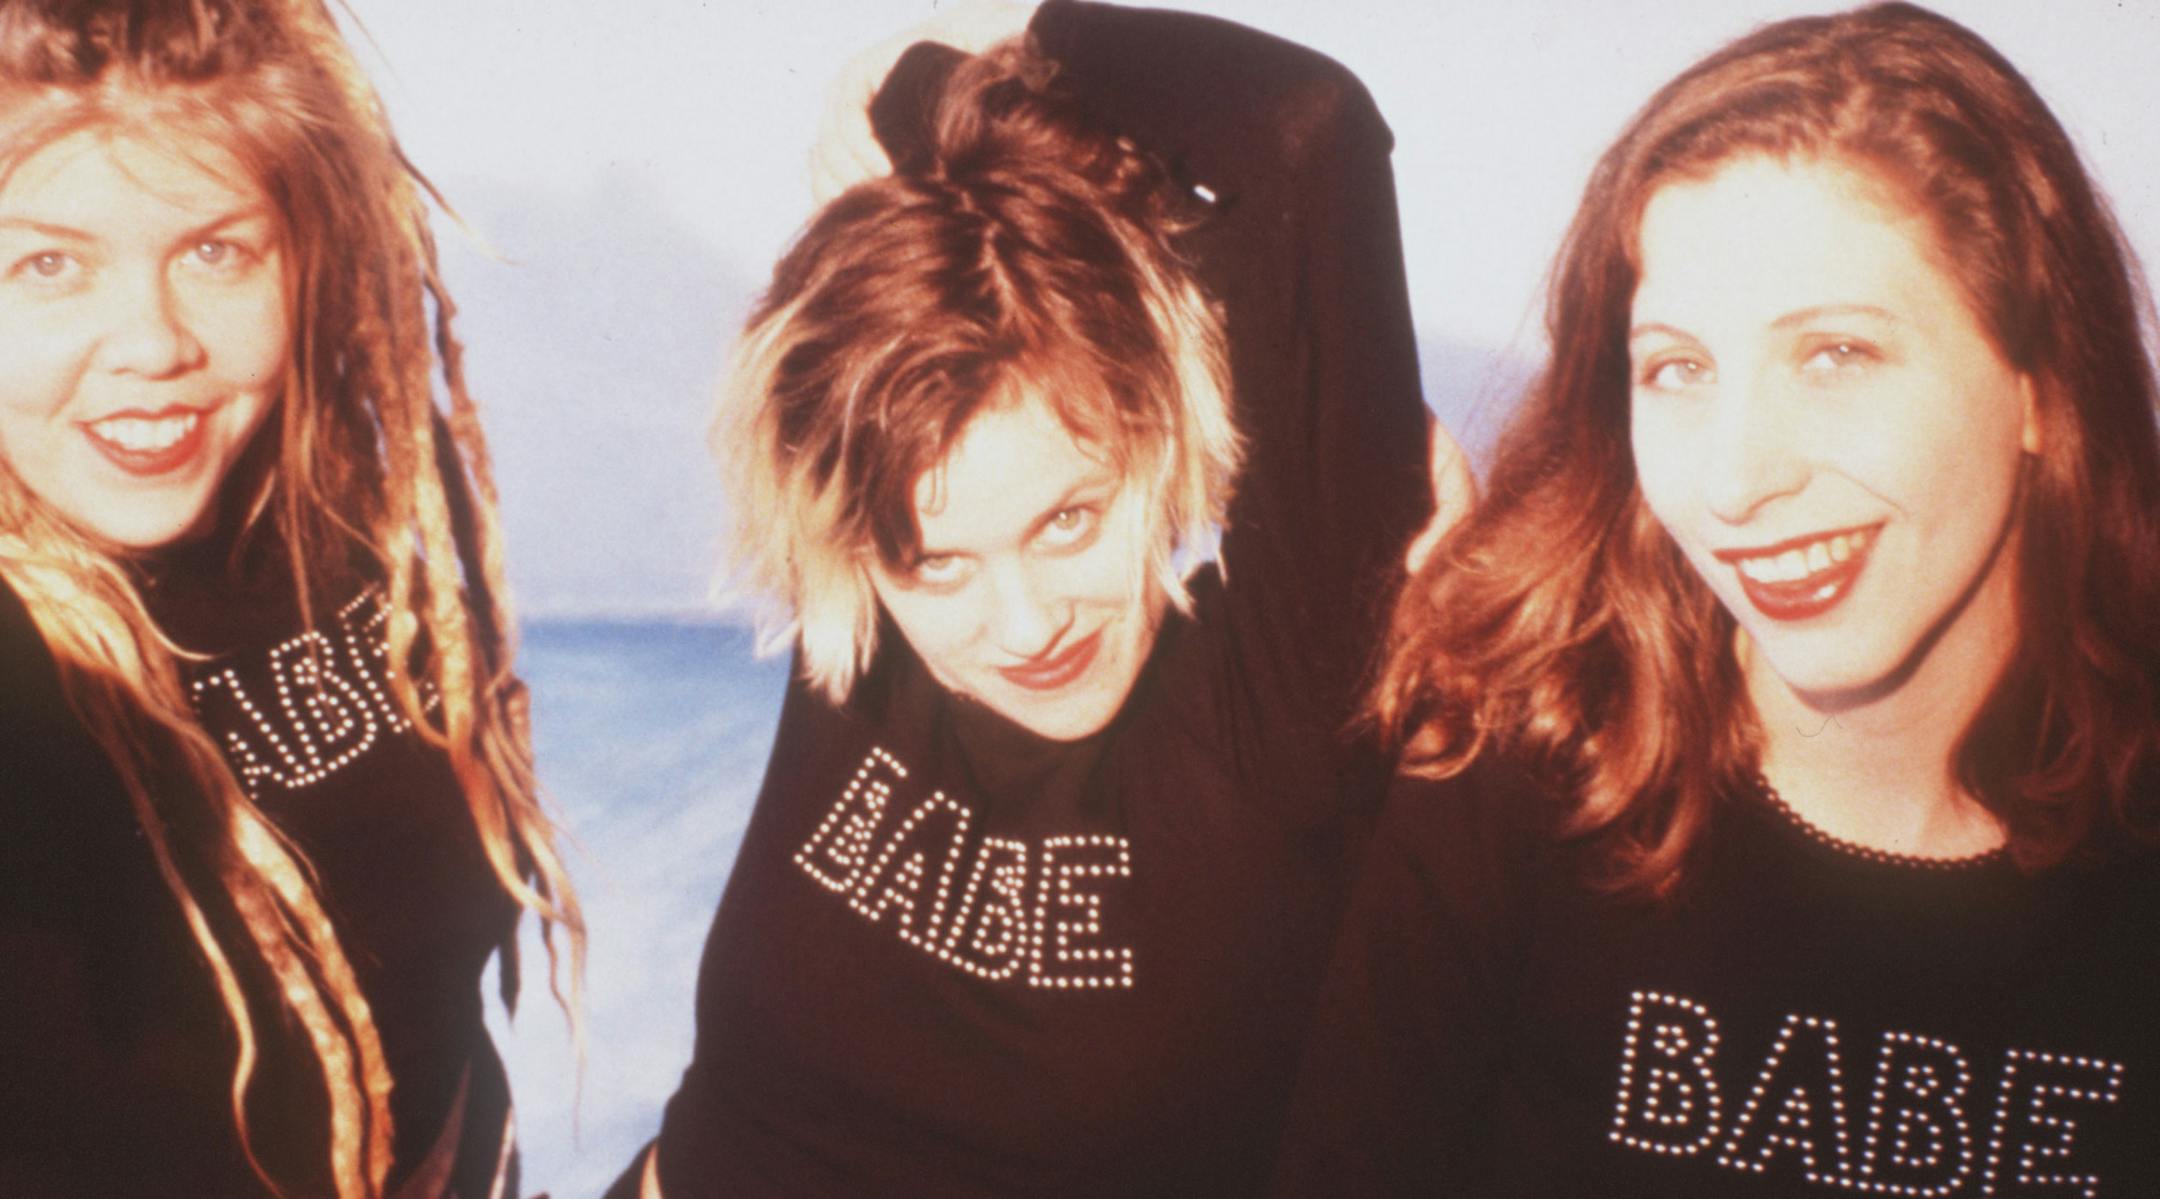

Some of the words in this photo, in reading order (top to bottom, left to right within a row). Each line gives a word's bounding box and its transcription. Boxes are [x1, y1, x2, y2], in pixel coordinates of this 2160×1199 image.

[190, 580, 441, 801] ABE
[793, 746, 1136, 988] BABE
[1608, 990, 2124, 1198] BABE
